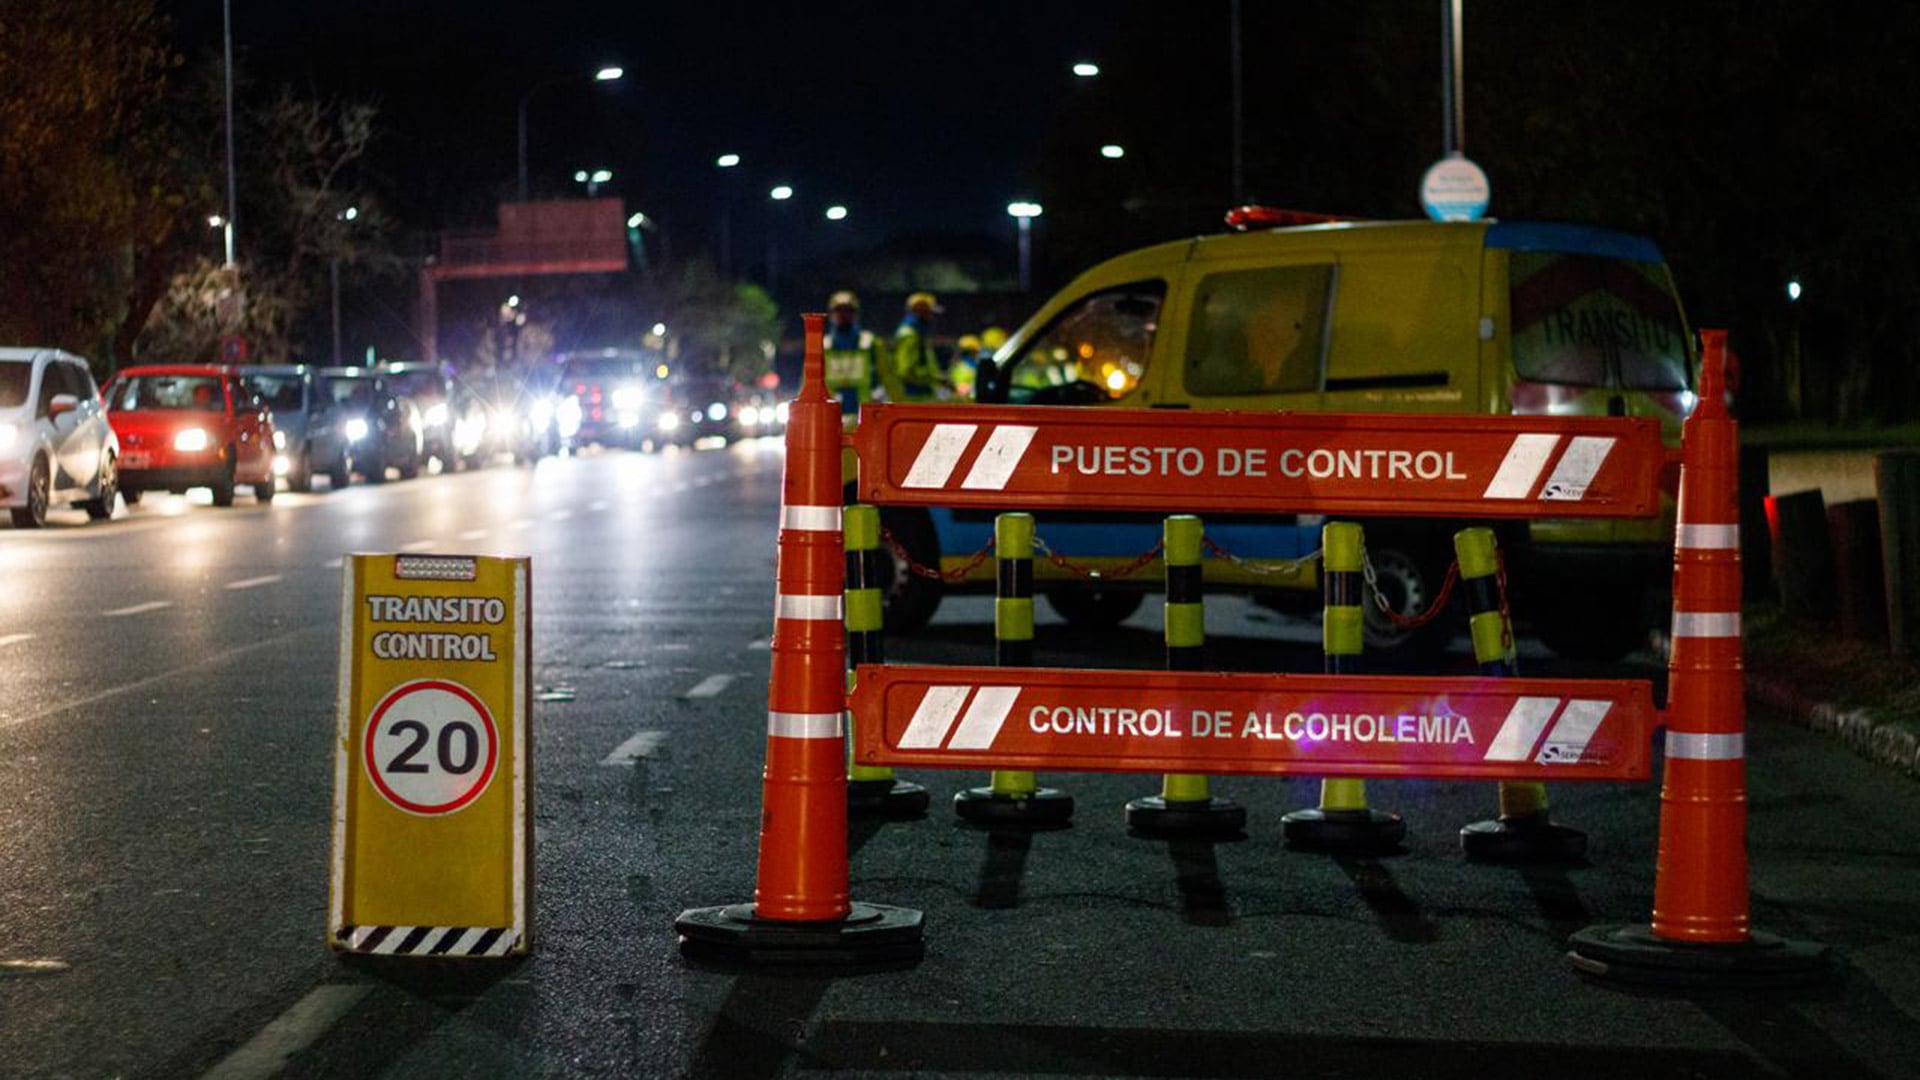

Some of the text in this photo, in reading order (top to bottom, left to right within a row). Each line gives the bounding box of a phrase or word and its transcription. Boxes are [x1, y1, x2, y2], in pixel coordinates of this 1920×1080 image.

[1051, 445, 1467, 480] PUESTO DE CONTROL
[367, 595, 505, 624] TRANSITO
[372, 631, 497, 661] CONTROL
[1029, 705, 1475, 744] CONTROL DE ALCOHOLEMIA
[386, 719, 479, 775] 20
